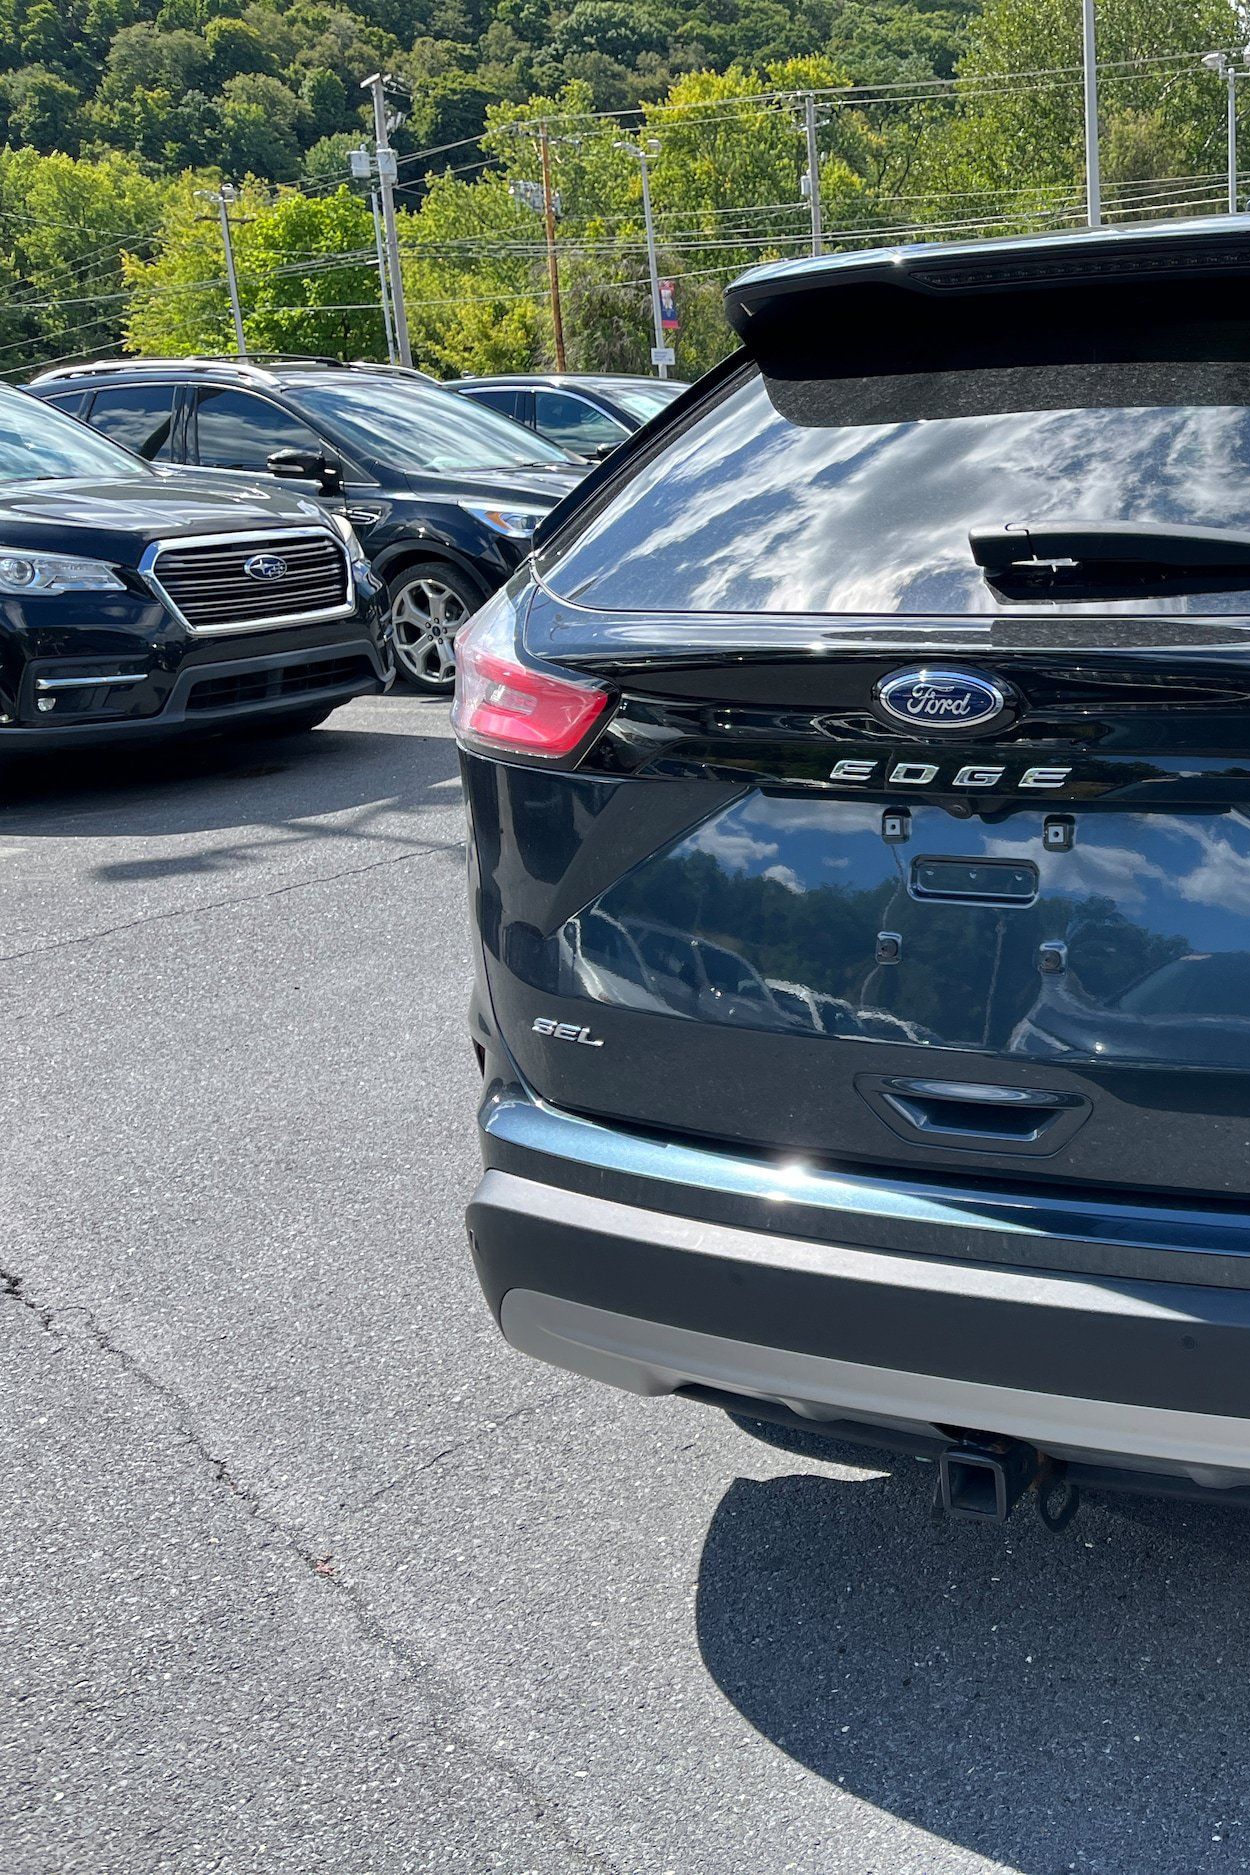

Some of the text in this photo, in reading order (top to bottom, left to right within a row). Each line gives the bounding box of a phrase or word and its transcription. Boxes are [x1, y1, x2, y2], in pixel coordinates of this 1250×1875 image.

[906, 682, 972, 716] Ford
[829, 759, 1073, 789] EDGE
[531, 1017, 605, 1047] SEL
